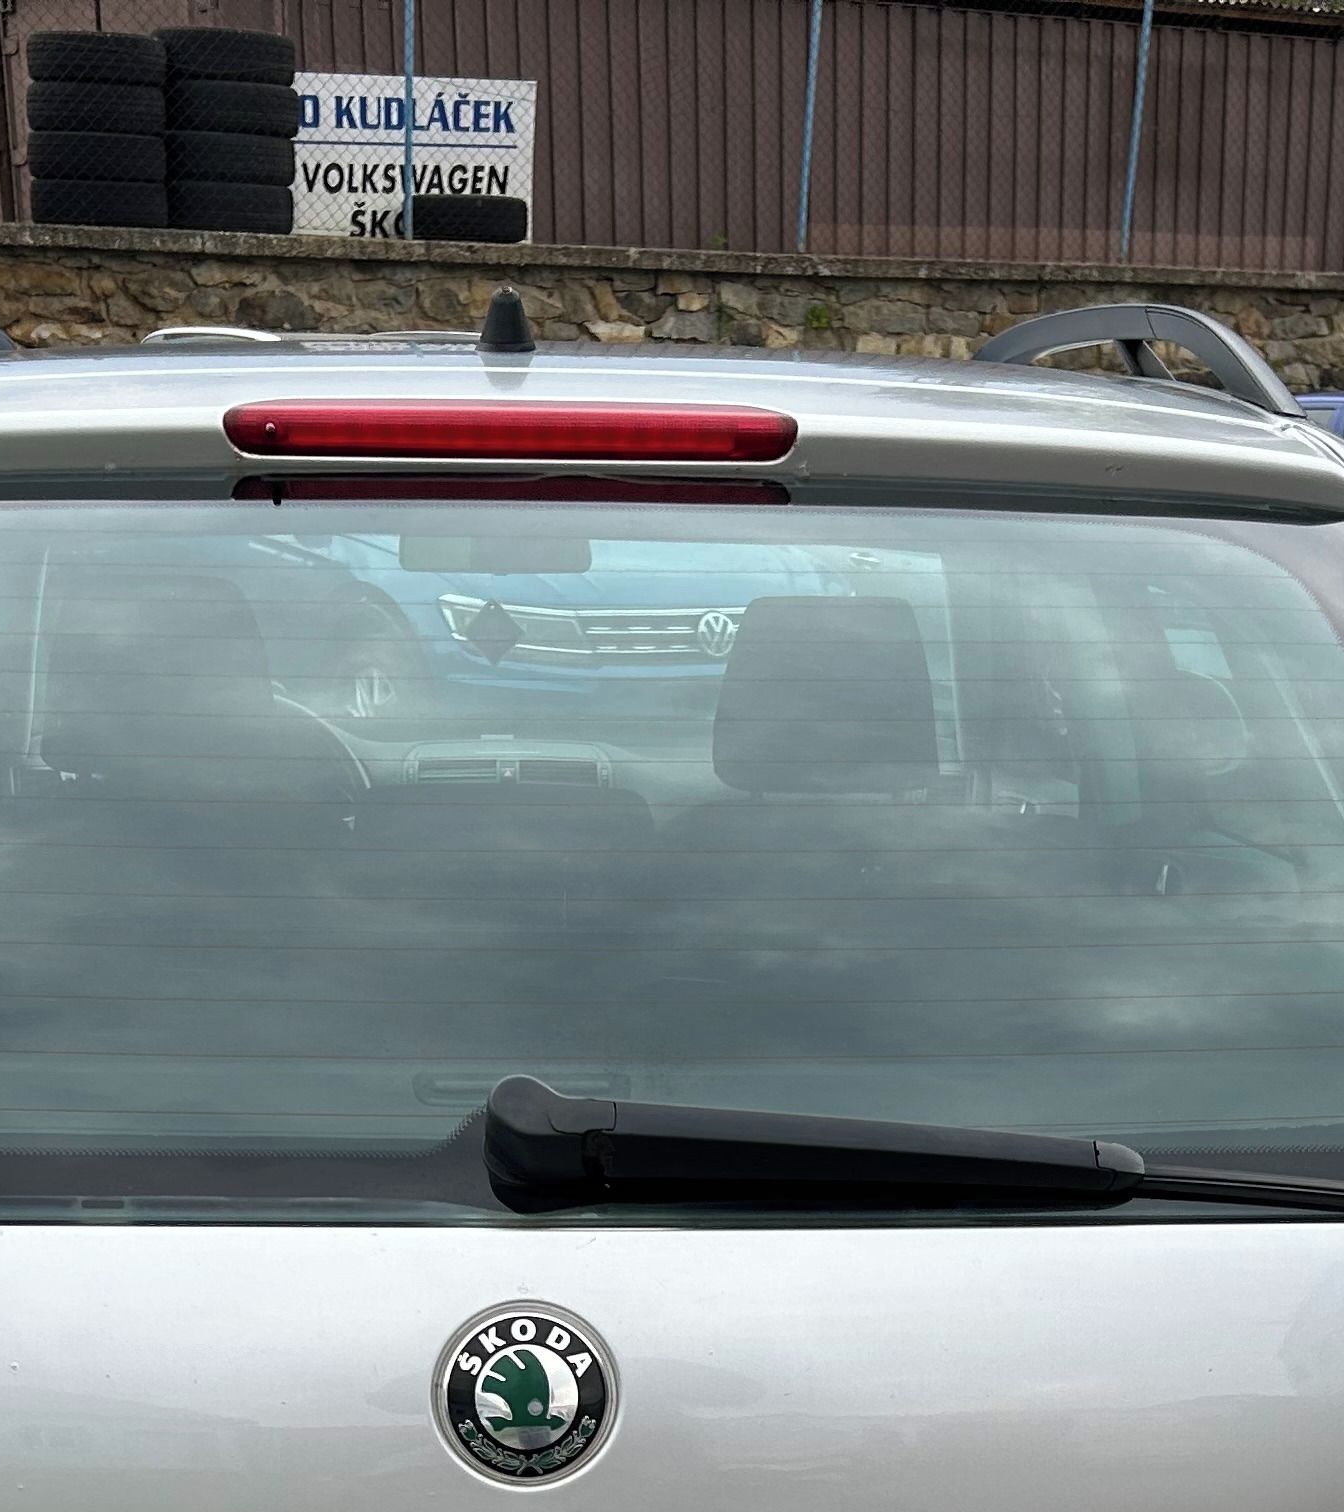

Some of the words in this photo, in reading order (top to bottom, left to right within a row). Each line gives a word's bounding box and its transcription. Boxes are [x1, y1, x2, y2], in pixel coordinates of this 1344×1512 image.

[335, 92, 515, 133] KUDLÁČEK
[302, 162, 509, 195] VOLKSWAGEN
[457, 1317, 594, 1378] ŠKODA
